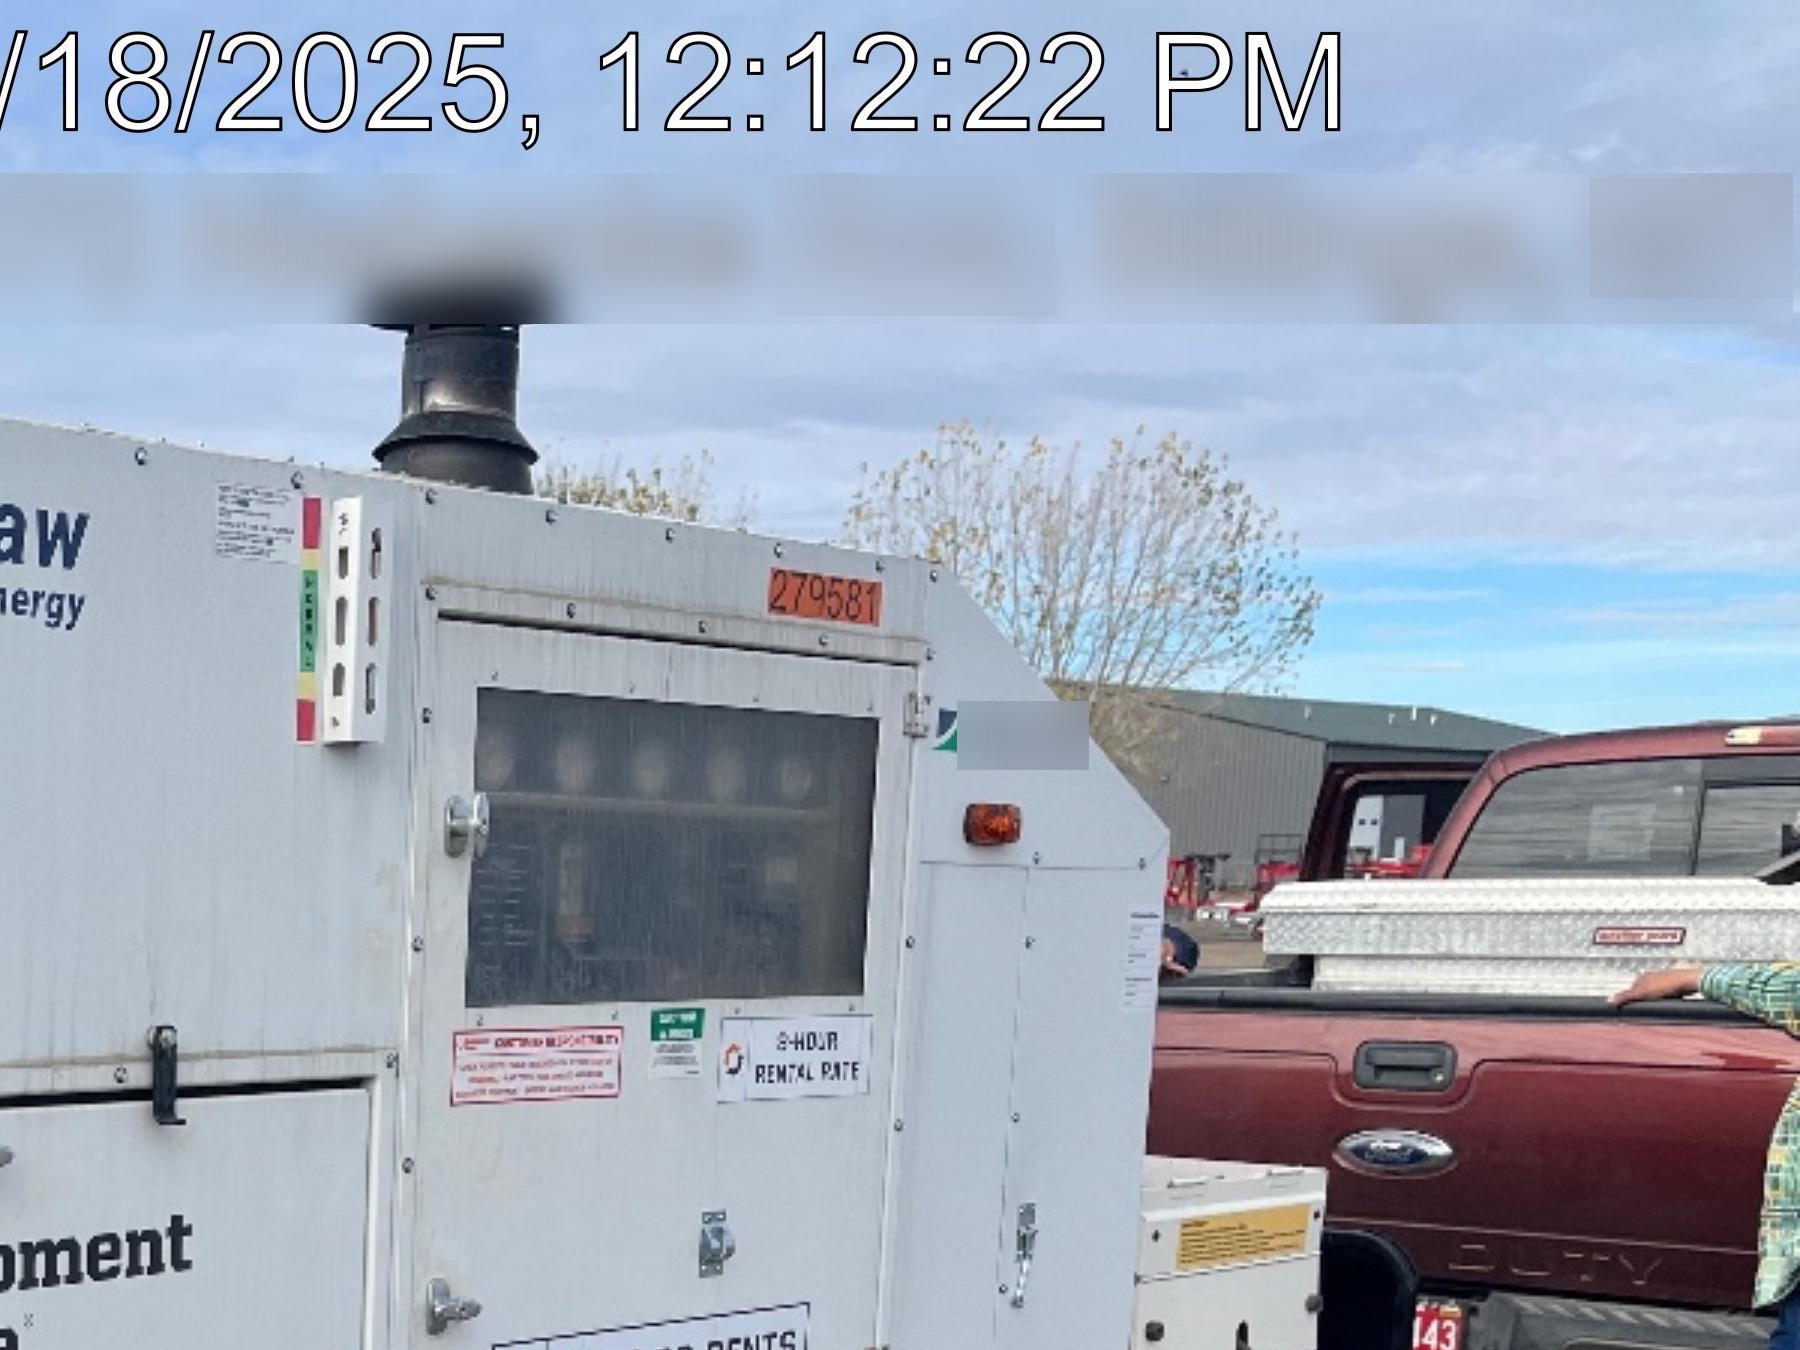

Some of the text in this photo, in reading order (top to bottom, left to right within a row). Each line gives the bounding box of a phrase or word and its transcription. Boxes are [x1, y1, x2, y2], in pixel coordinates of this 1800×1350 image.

[769, 569, 877, 623] 279581
[754, 1060, 861, 1085] RENTAL RATE
